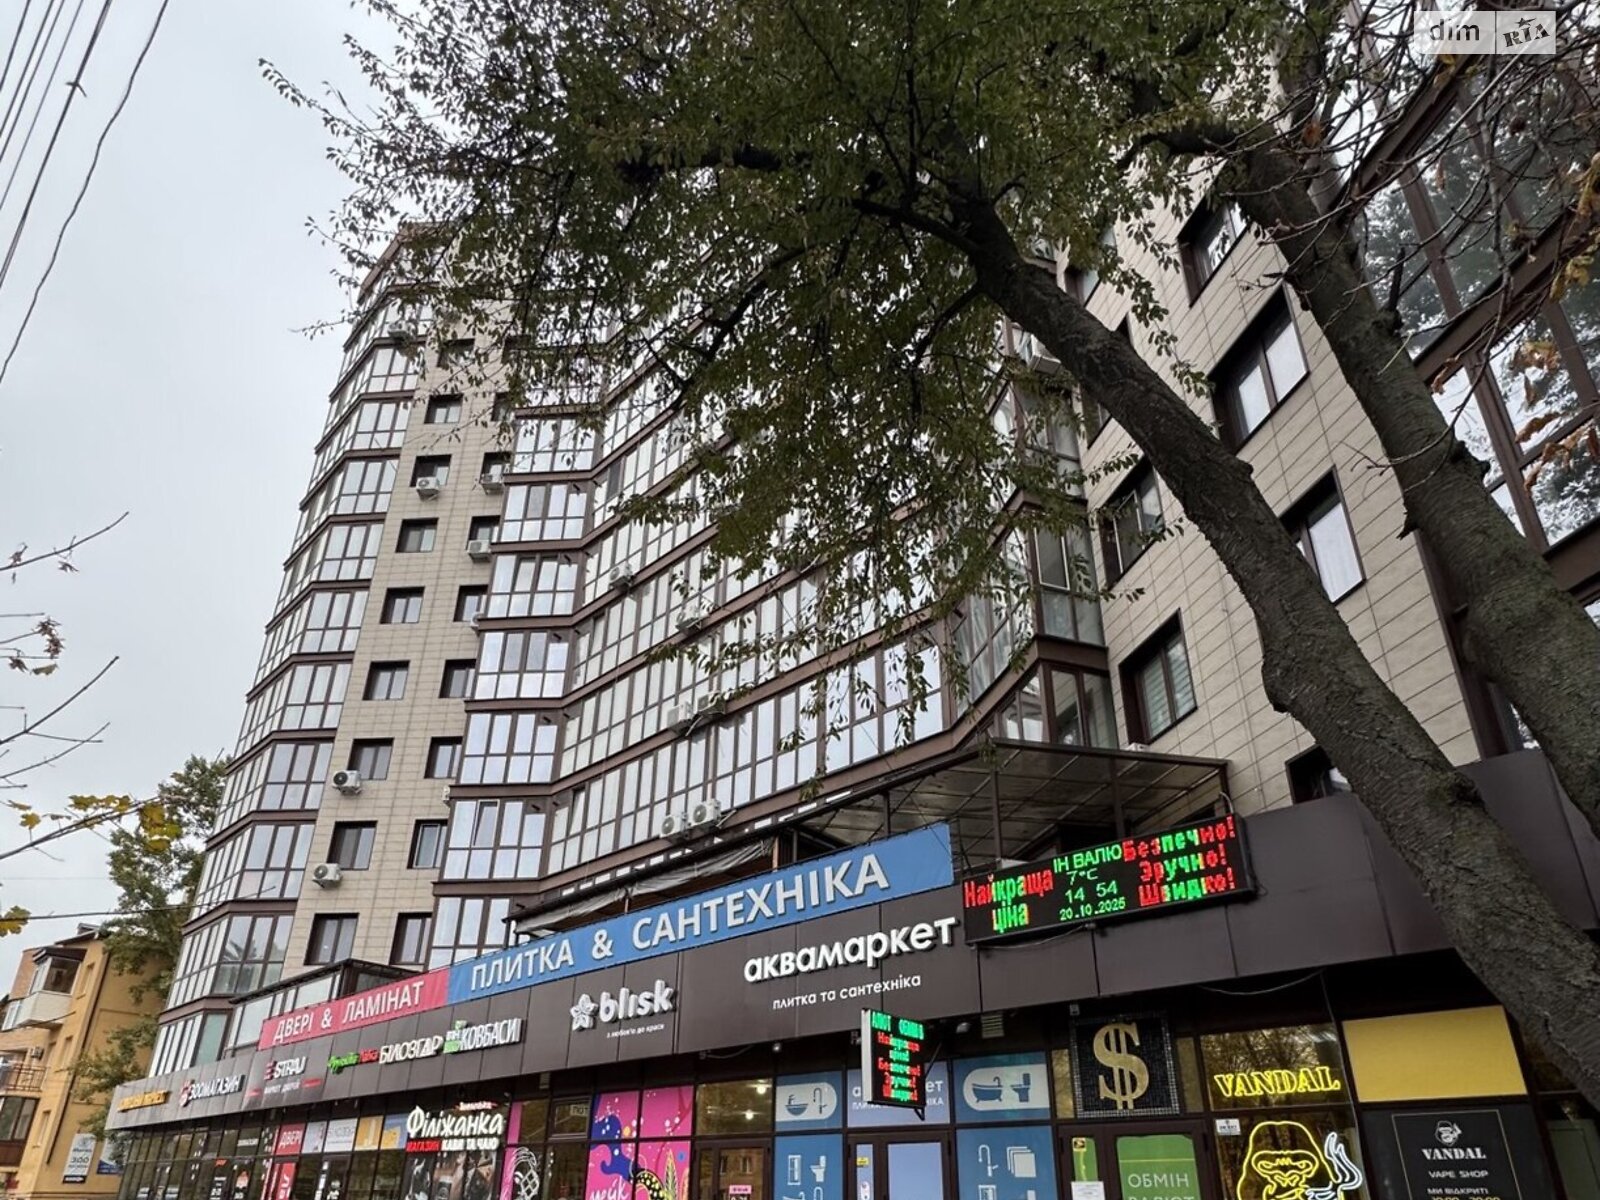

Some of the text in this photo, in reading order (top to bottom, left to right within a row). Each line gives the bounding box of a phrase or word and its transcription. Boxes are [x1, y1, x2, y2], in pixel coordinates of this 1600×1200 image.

[1074, 844, 1122, 868] ВАЛЮ
[1122, 815, 1236, 863] Безпечно!
[1139, 843, 1227, 882] Зручно!
[963, 868, 1053, 909] Найкраща
[1138, 867, 1236, 908] Швидко!
[471, 853, 889, 991] ПЛИТКА & САНТЕХНІКА
[992, 902, 1029, 934] ціна
[744, 917, 957, 982] аквамаркет
[600, 979, 675, 1022] blisk
[773, 974, 921, 1010] плитка та сантехніка
[272, 981, 425, 1045] ДВЕРІ & ЛАМІНАТ
[1213, 1066, 1341, 1097] VANDAL
[406, 1105, 504, 1139] Філіжанка
[1421, 1147, 1487, 1160] VANDAL
[1127, 1173, 1190, 1189] ОБМІН
[1428, 1169, 1489, 1178] VAPE SHOP
